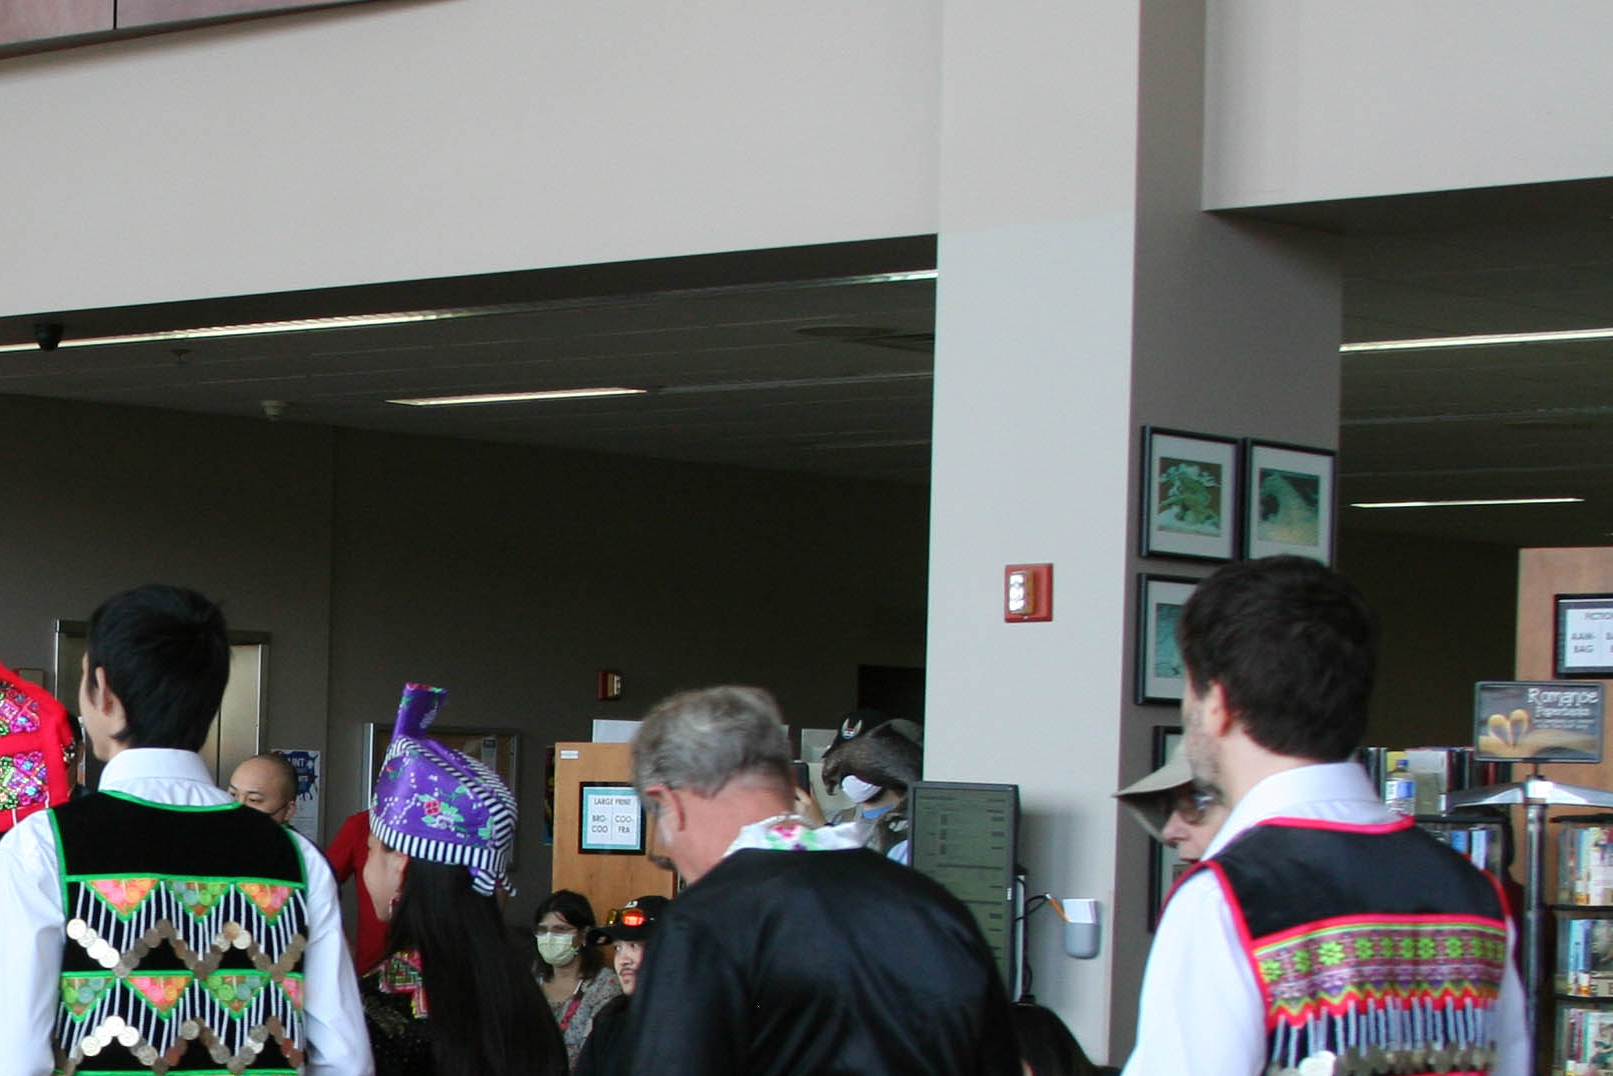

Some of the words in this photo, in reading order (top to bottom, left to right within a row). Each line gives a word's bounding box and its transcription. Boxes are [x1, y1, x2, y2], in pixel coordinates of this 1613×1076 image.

[593, 798, 613, 806] LARGE
[615, 798, 631, 806] PRINT
[591, 824, 609, 834] COO
[617, 825, 631, 833] FRA
